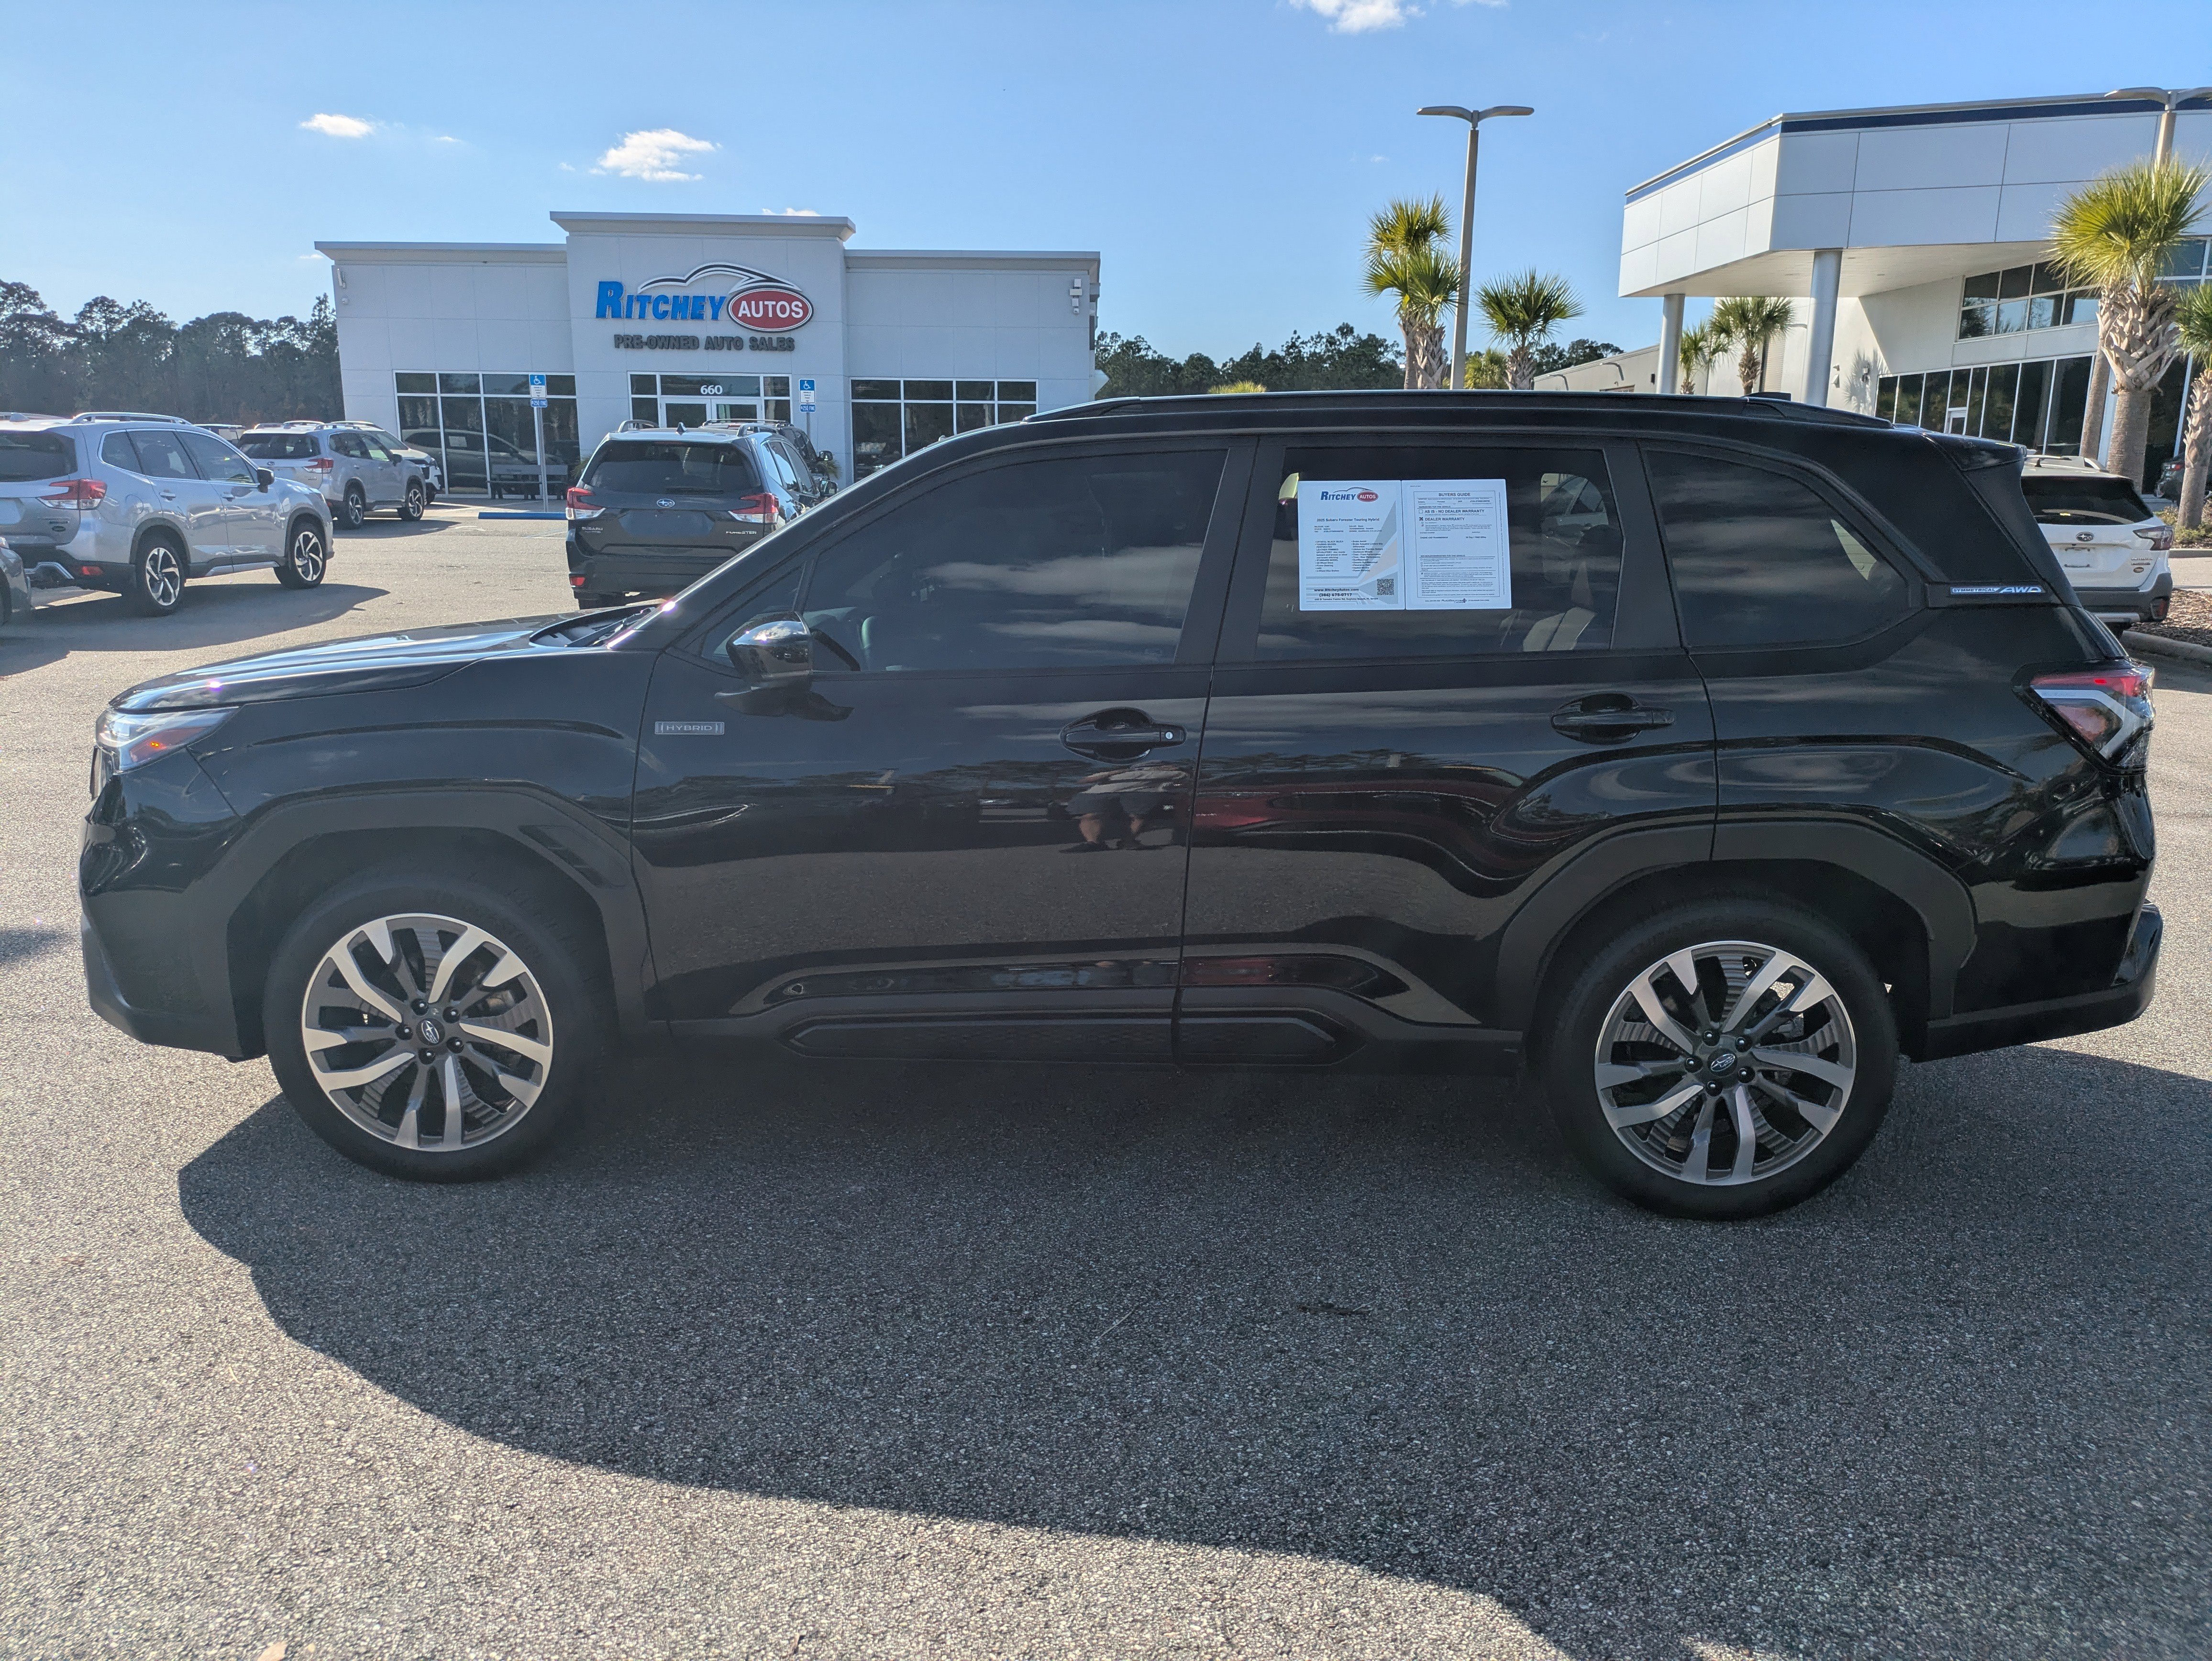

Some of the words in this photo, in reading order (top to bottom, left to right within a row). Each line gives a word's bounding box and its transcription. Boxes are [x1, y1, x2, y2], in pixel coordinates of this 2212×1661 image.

[596, 281, 726, 320] RITCHEY
[738, 301, 803, 318] AUTOS
[614, 334, 699, 350] PRE-OWNED
[705, 336, 743, 350] AUTO
[749, 337, 795, 351] SALES
[701, 386, 722, 394] 660
[1321, 491, 1356, 500] RITCHEY
